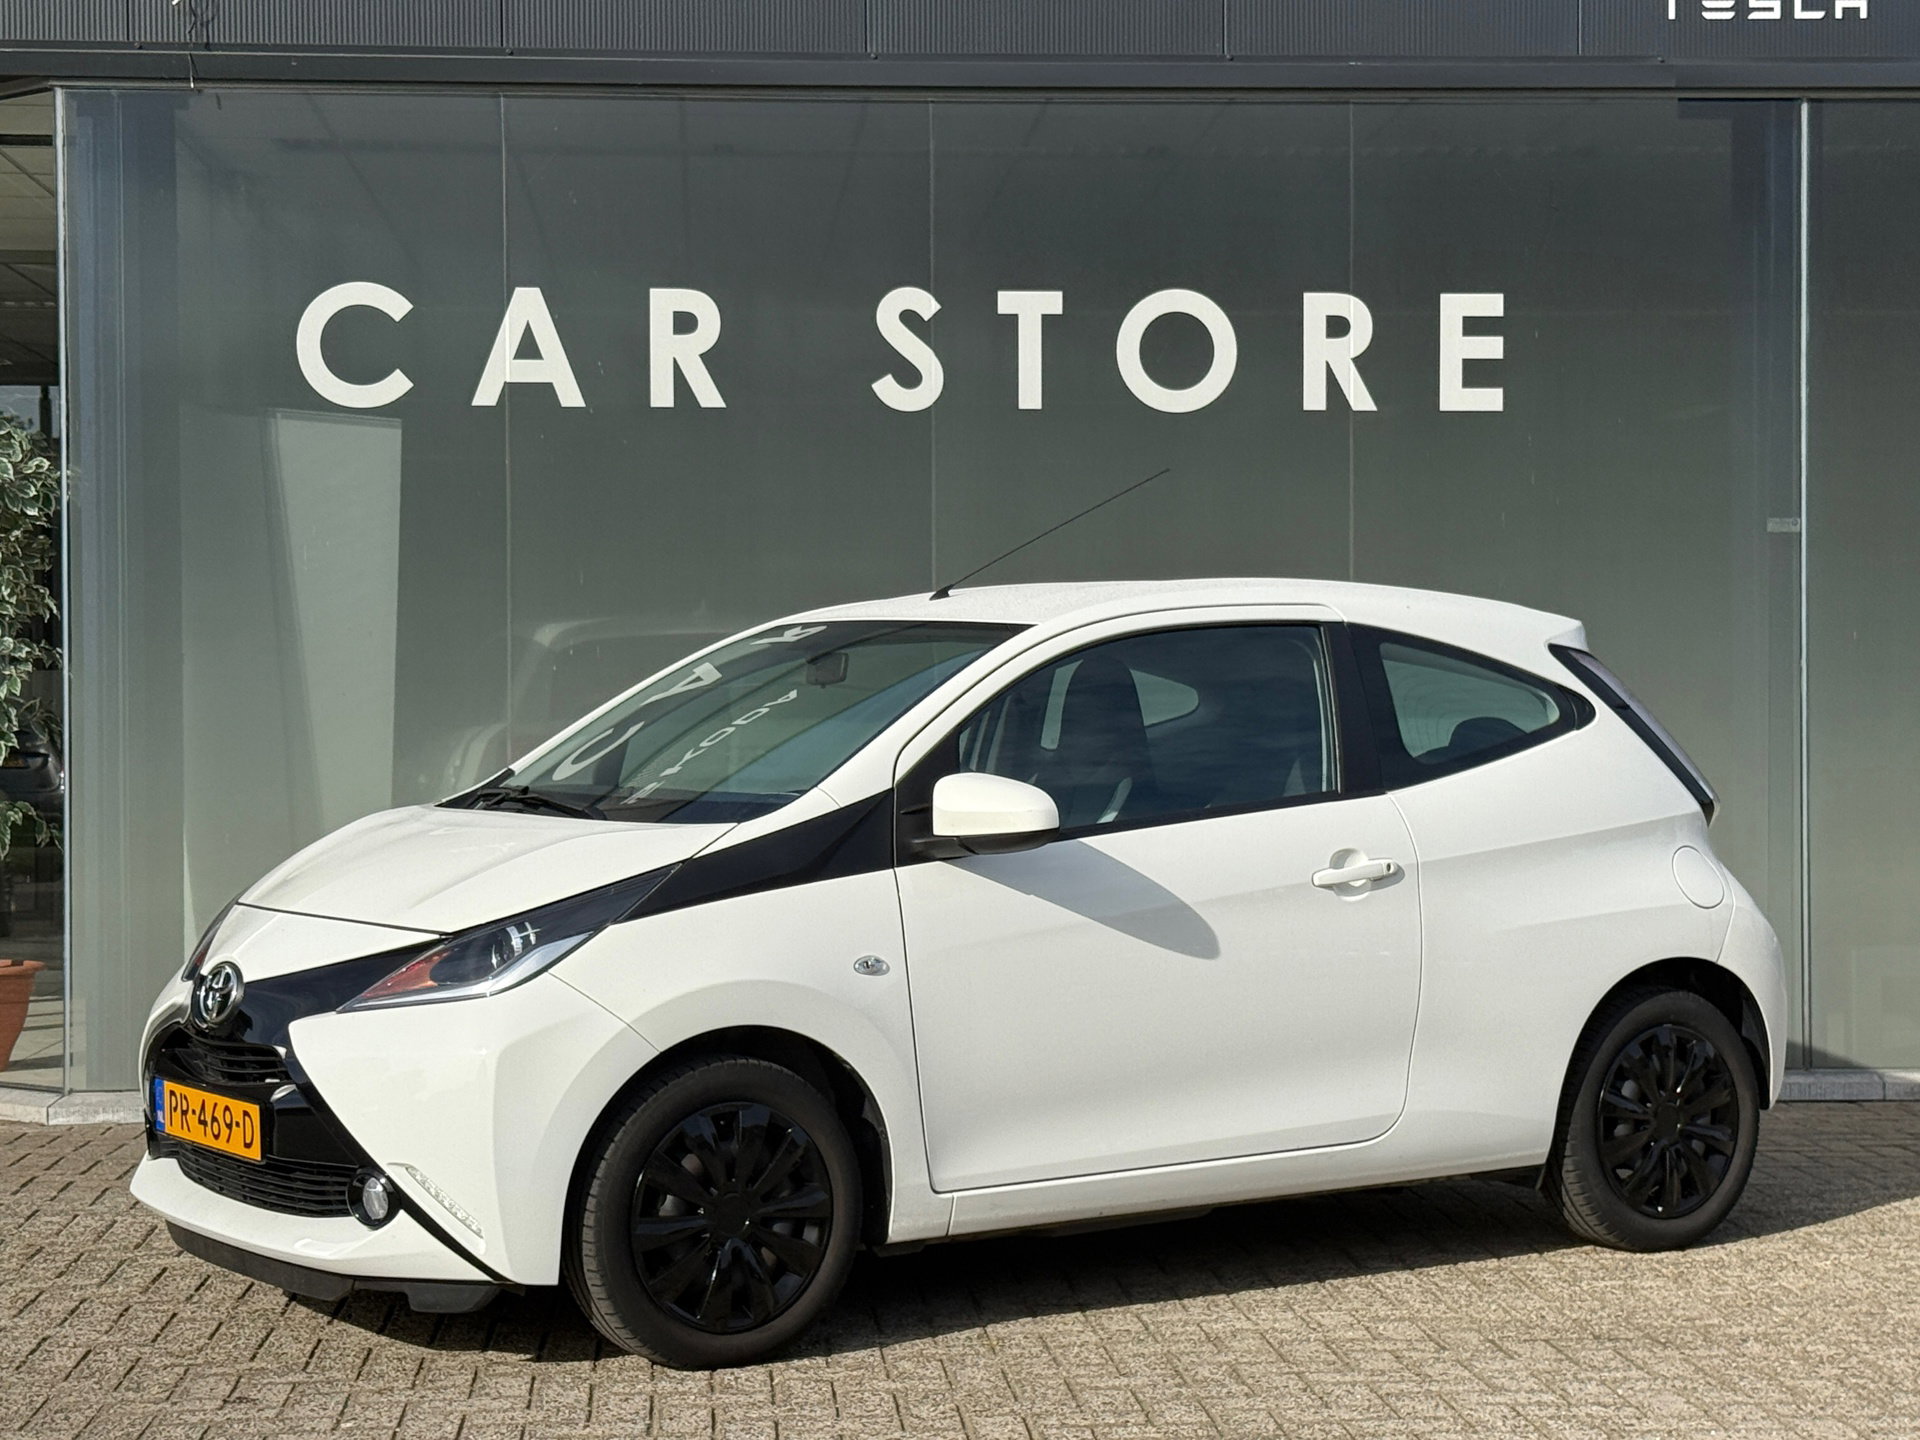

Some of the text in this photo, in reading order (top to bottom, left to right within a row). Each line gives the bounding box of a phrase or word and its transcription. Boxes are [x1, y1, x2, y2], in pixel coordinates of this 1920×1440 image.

[296, 281, 1504, 413] CAR STORE
[168, 1088, 255, 1150] PR-469-D
